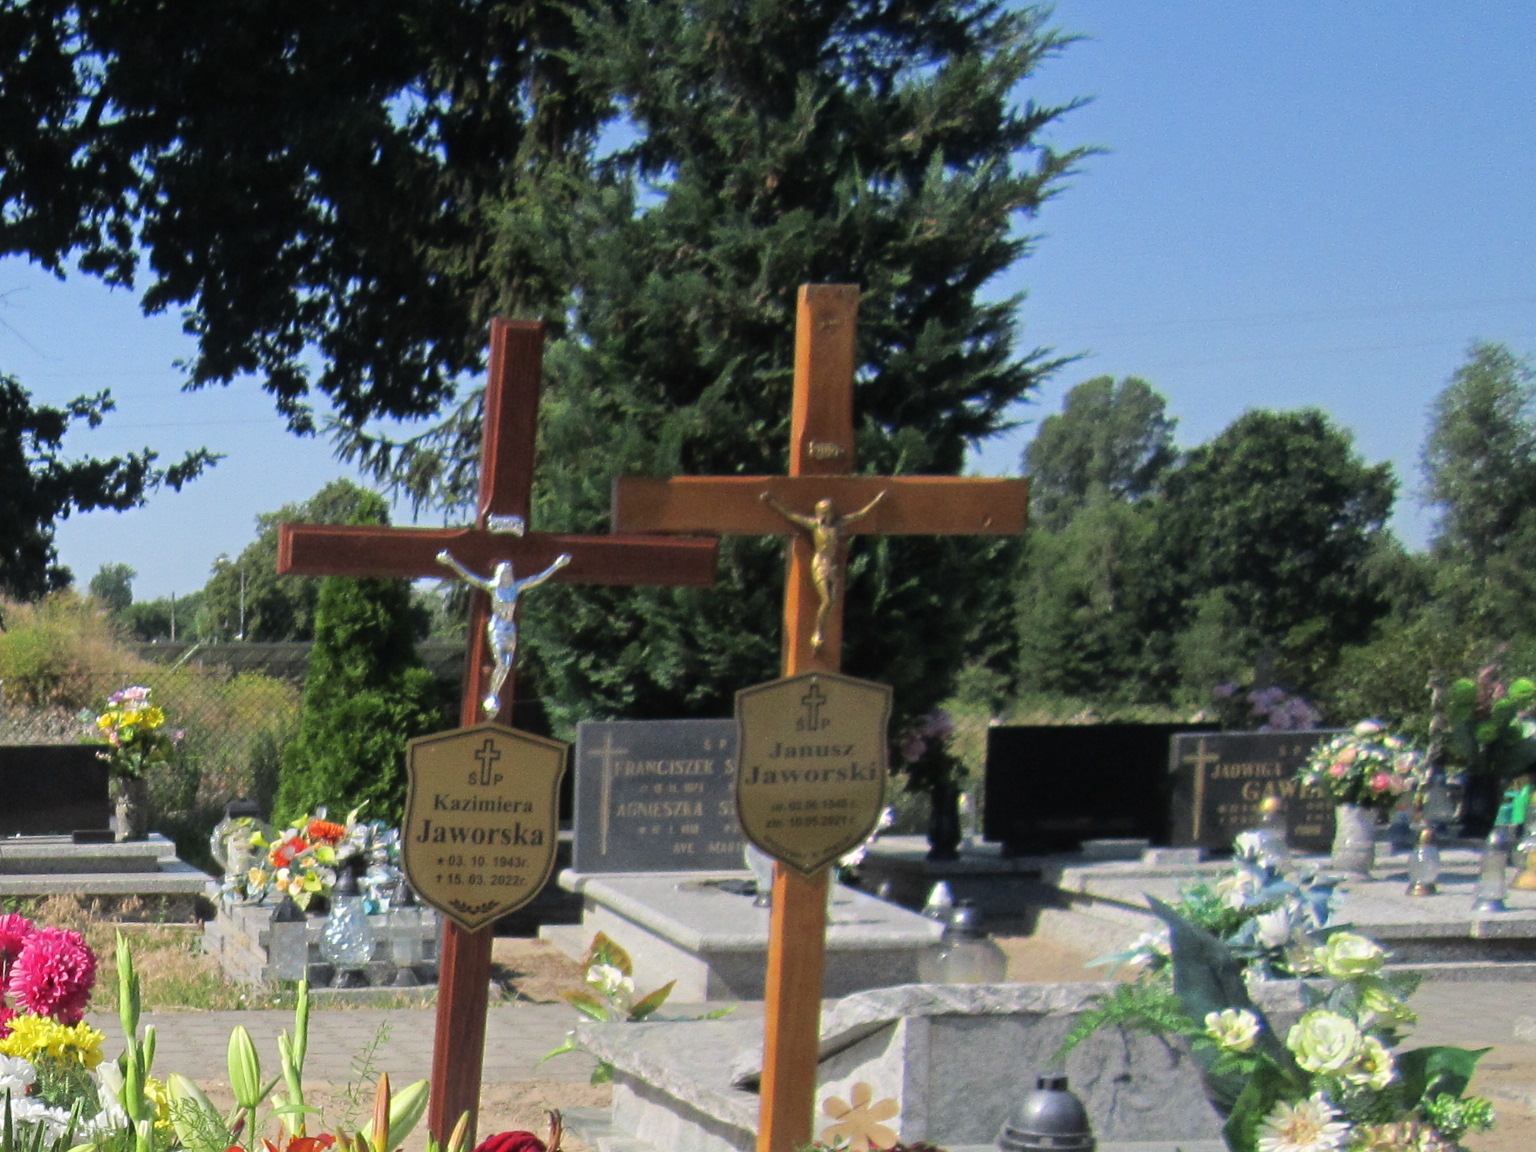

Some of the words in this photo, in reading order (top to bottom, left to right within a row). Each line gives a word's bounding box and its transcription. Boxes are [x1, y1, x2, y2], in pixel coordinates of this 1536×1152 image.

[768, 742, 855, 759] Janusz
[614, 758, 714, 776] FRANCISZEK
[745, 761, 877, 784] Jaworski
[493, 774, 503, 786] P
[433, 793, 534, 814] Kazimiera
[416, 819, 544, 846] Jaworska
